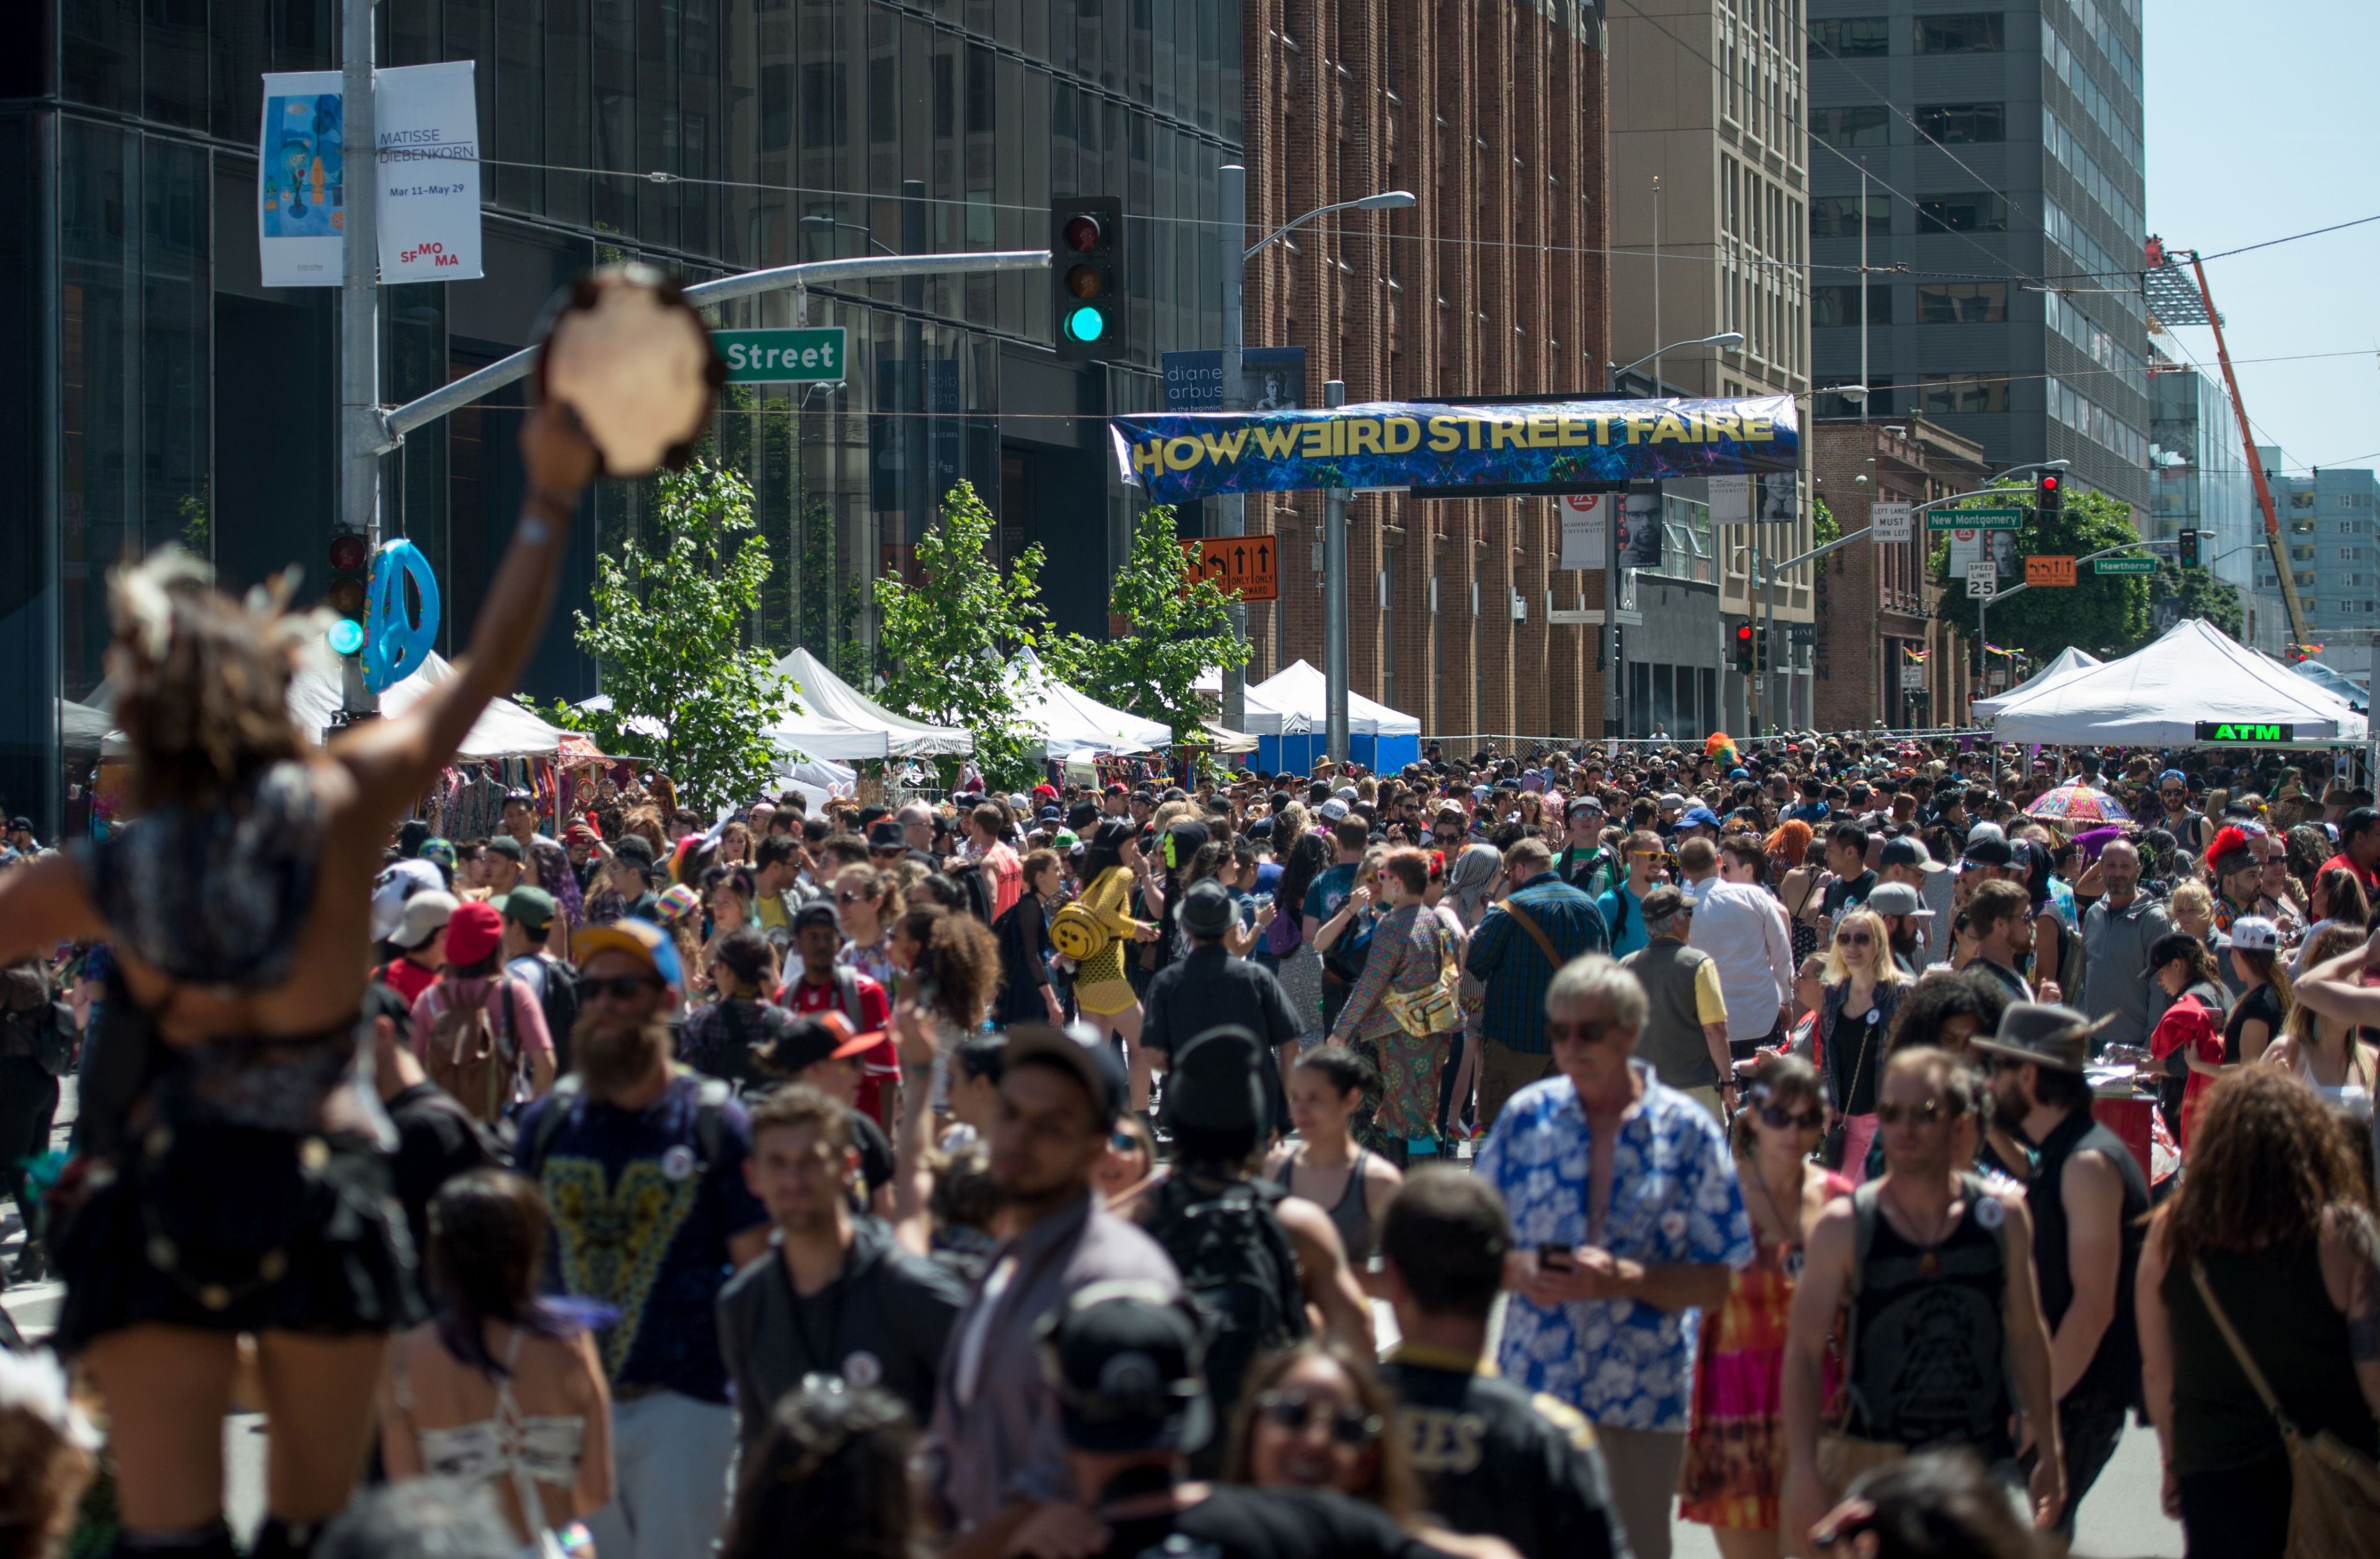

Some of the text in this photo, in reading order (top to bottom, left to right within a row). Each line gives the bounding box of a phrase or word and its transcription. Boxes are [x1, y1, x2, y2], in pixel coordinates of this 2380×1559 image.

[379, 128, 440, 145] MATISSE
[379, 146, 474, 164] DIEBENKORN
[389, 187, 408, 197] Mar
[452, 184, 464, 194] 29
[726, 341, 834, 371] Street
[1168, 366, 1222, 381] diane
[1169, 382, 1223, 398] arbus
[1191, 405, 1222, 413] beginnin
[1132, 410, 1774, 477] HOW WEIRD STREET FAIRE
[1879, 518, 1904, 526] MUST
[1931, 514, 2017, 526] New Montgomery
[2100, 562, 2151, 570] Hawthorne
[1232, 576, 1250, 585] ONLY
[1254, 575, 1273, 584] ONLY
[1243, 586, 1268, 595] OWARD
[1970, 581, 1993, 595] 25
[2214, 724, 2280, 740] ATM
